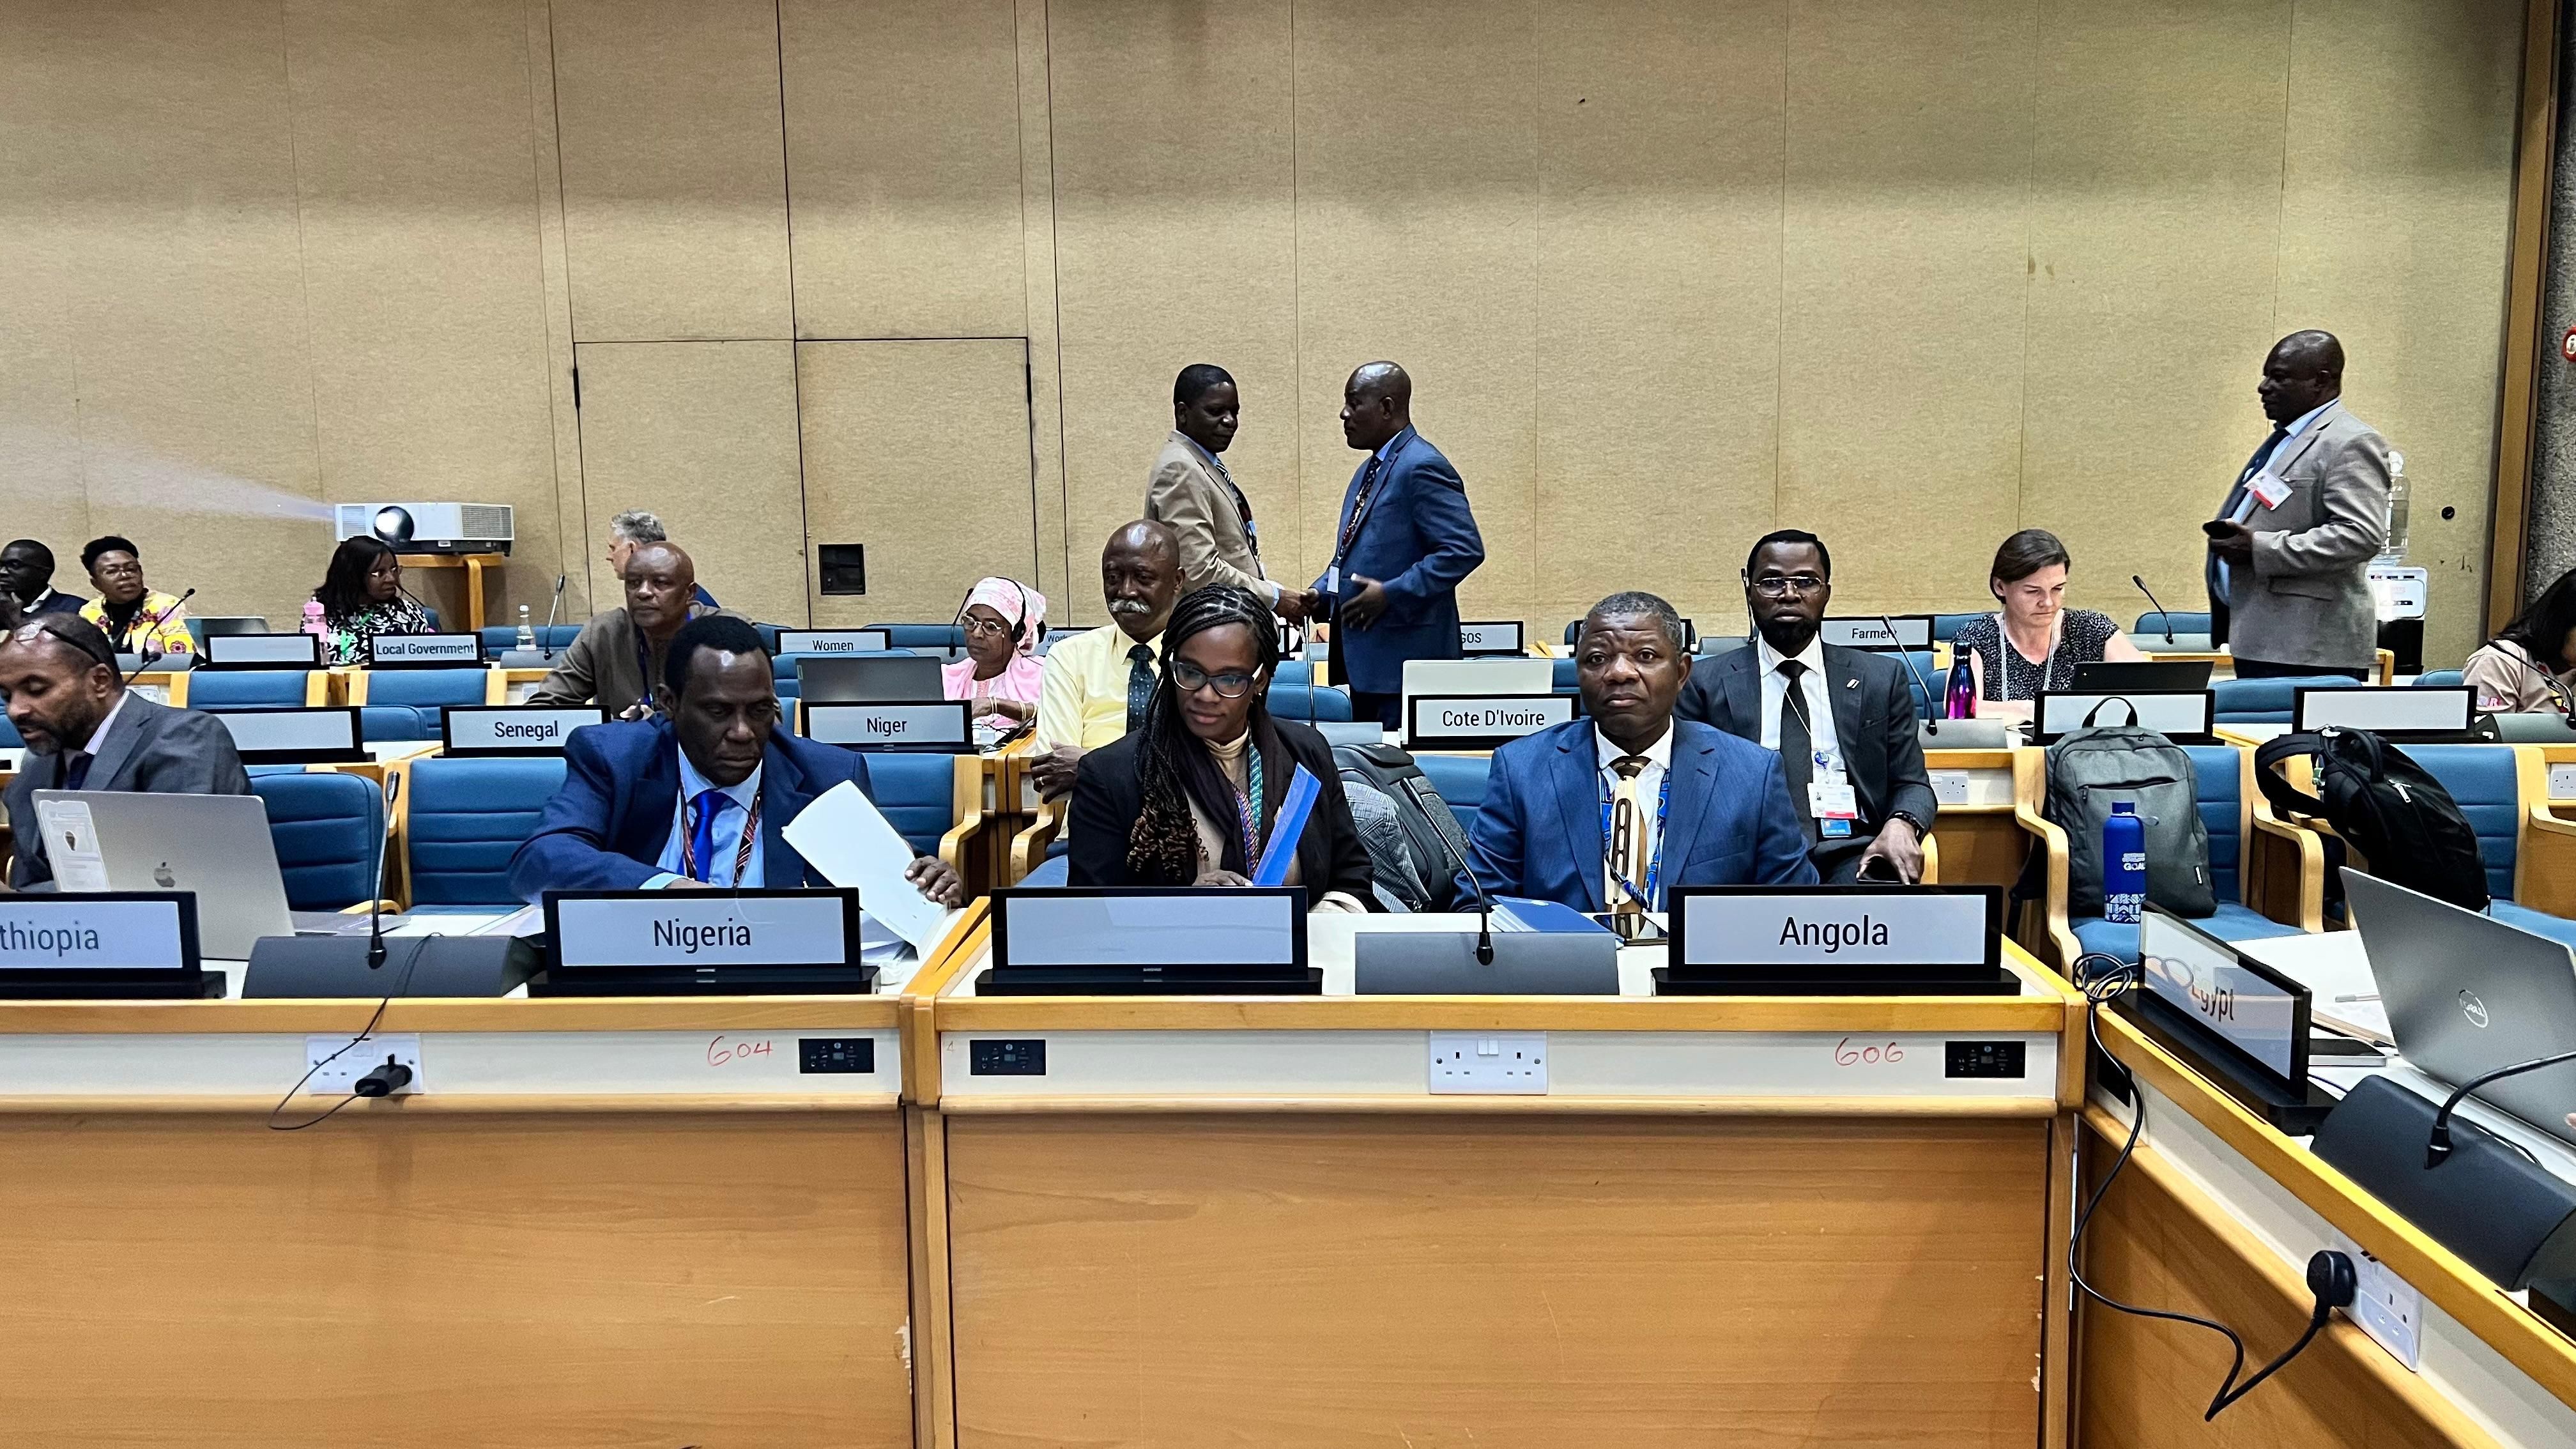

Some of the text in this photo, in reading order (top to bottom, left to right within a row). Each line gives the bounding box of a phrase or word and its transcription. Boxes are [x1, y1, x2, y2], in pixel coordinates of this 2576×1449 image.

[1461, 632, 1482, 643] GOS
[1851, 628, 1897, 639] Farmer
[376, 643, 475, 655] Local Government
[812, 640, 854, 651] Women
[866, 716, 907, 737] Niger
[1443, 709, 1545, 726] Cote D'Ivoire
[494, 719, 558, 742] Senegal
[0, 921, 99, 957] thiopia
[653, 917, 752, 954] Nigeria
[1778, 914, 1889, 954] Angola
[707, 1035, 773, 1066] 604
[1835, 1037, 1903, 1066] 606
